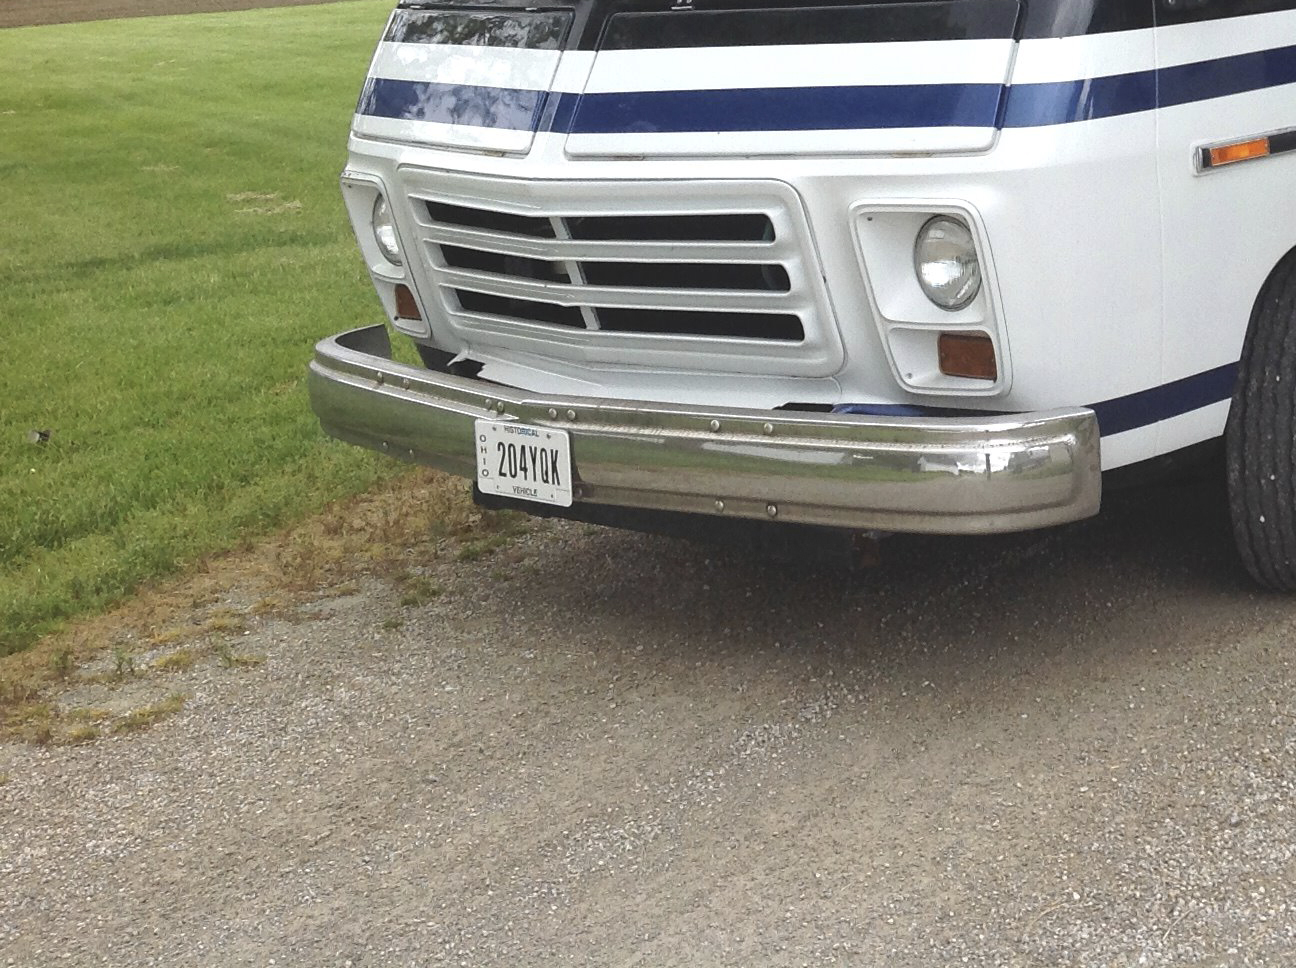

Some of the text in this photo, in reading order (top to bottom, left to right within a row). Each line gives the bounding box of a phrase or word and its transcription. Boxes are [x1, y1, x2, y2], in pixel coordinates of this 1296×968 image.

[504, 425, 539, 437] HISTORICAL
[479, 434, 489, 477] OHIO
[497, 441, 561, 486] 204YQK
[512, 486, 538, 497] VEHICLE
